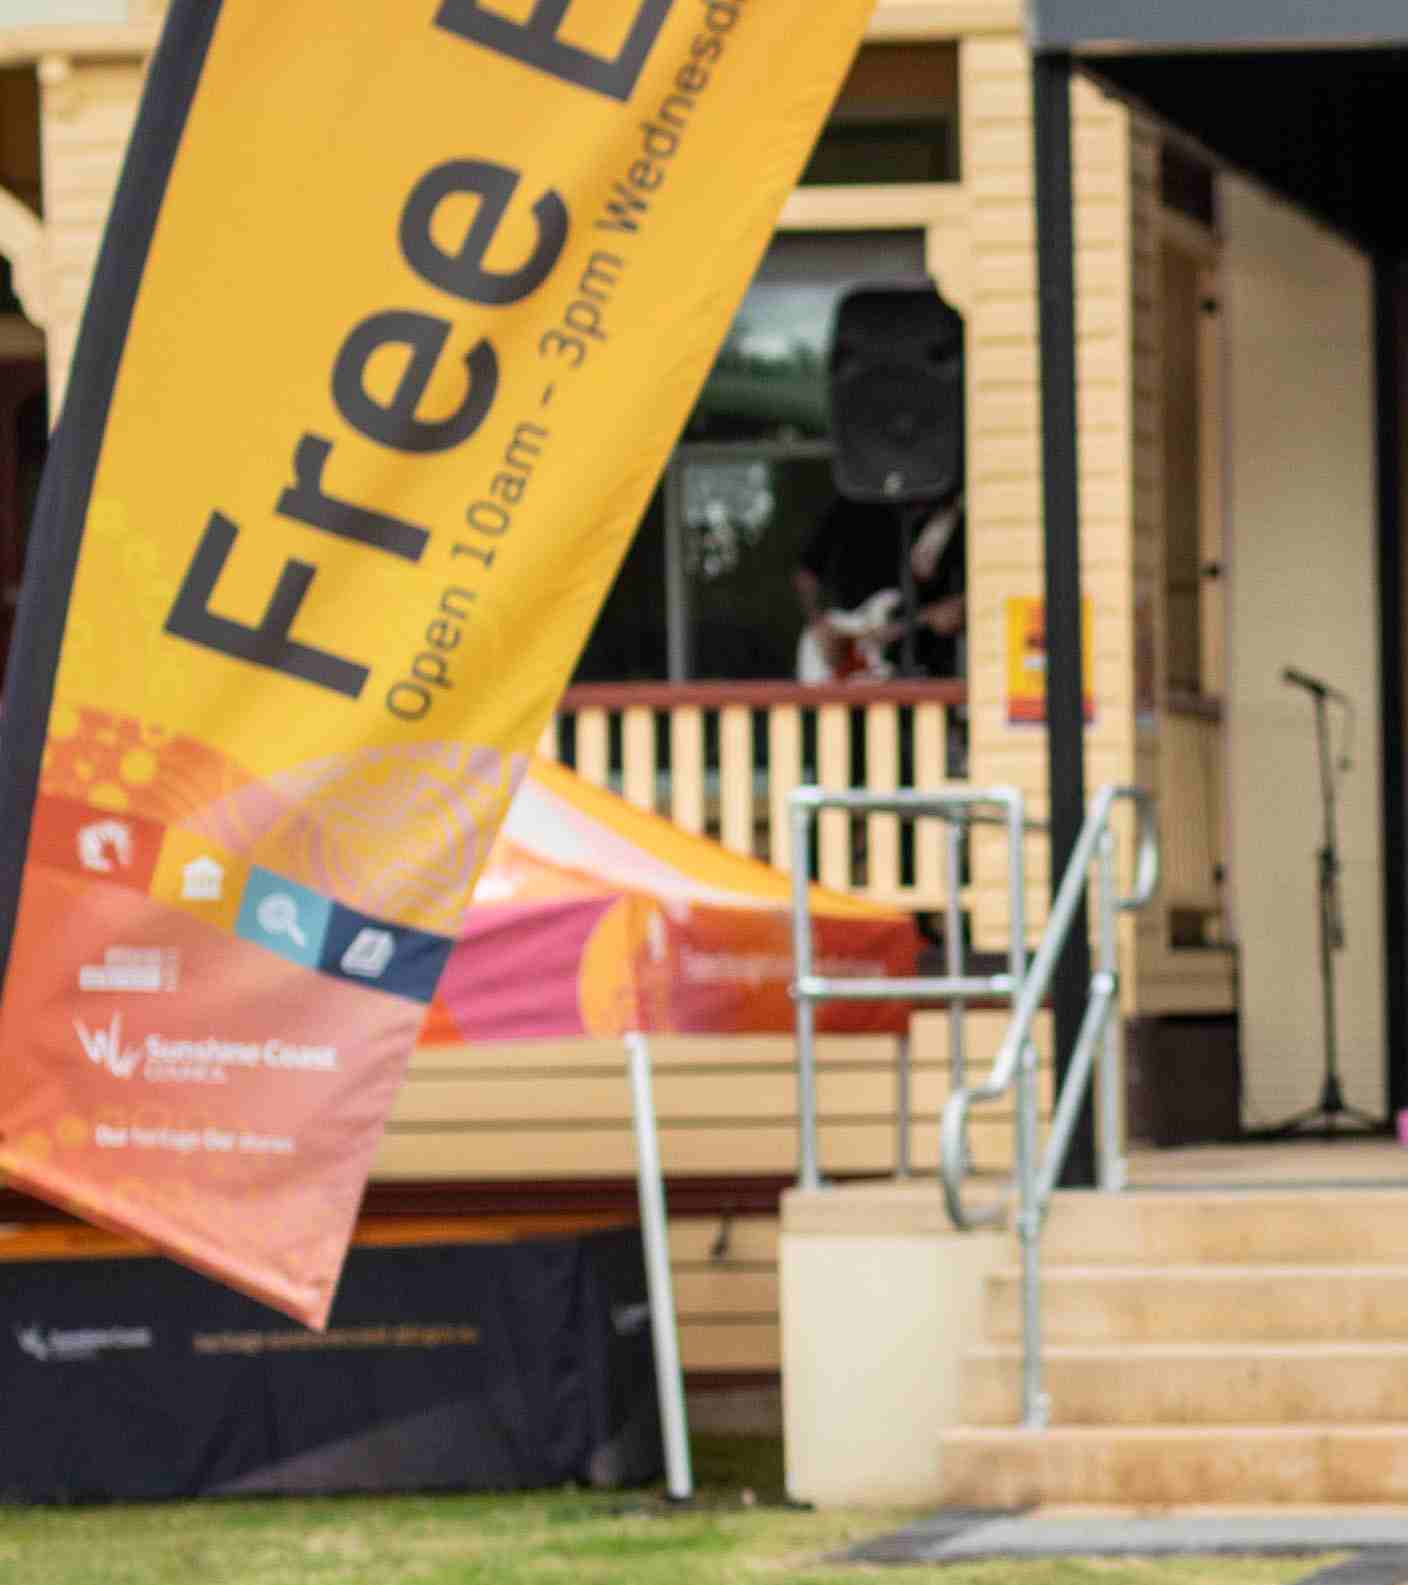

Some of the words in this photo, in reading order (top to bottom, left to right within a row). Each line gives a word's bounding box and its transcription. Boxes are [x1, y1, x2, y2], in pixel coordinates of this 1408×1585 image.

[163, 155, 569, 700] Free
[386, 585, 477, 722] Open
[451, 420, 549, 569] 10am
[540, 249, 626, 368] 3pm
